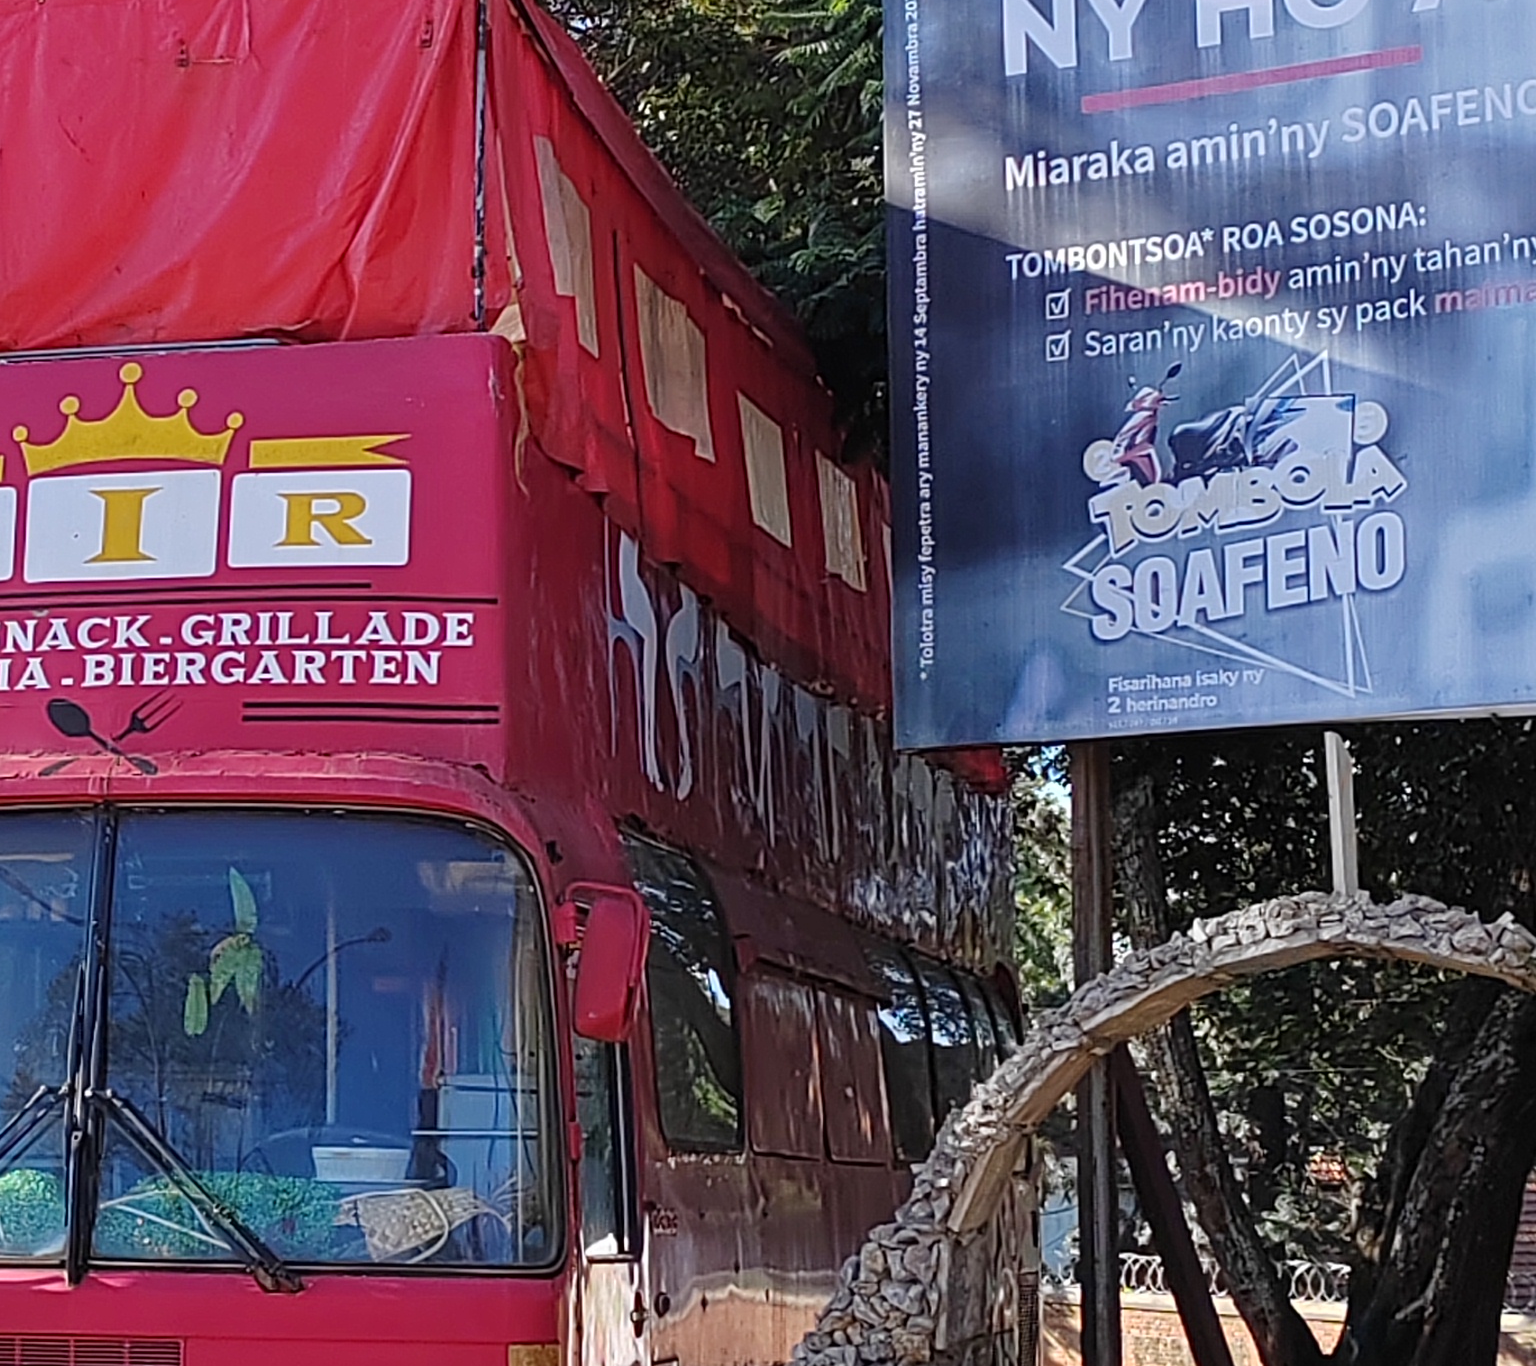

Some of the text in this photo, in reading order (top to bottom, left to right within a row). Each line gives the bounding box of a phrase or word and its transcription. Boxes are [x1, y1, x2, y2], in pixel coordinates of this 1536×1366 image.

[905, 24, 921, 105] Novambra
[907, 110, 923, 128] 27
[1004, 140, 1156, 192] Miaraka
[1167, 118, 1330, 172] amin'ny
[1223, 221, 1283, 253] ROA
[1290, 202, 1427, 243] SOSONA:
[912, 234, 930, 324] Septambra
[1085, 266, 1280, 314] Fihenam-bidy
[1288, 252, 1407, 289] amin'ny
[913, 327, 928, 348] 14
[1084, 321, 1205, 356] Saran'ny
[1213, 308, 1310, 341] kaonty
[1317, 305, 1348, 334] sy
[1356, 288, 1427, 331] pack
[914, 350, 929, 371] ny
[914, 375, 931, 467] manankery
[918, 471, 934, 499] ary
[1089, 445, 1407, 558] TOMBOLA
[918, 501, 935, 562] fepetra
[918, 565, 936, 606] misy
[1091, 510, 1406, 641] SOAFENO
[919, 609, 935, 668] Tolotra
[1107, 694, 1217, 714] 2 herinandro
[1108, 668, 1264, 693] Fisarihana isaky ny
